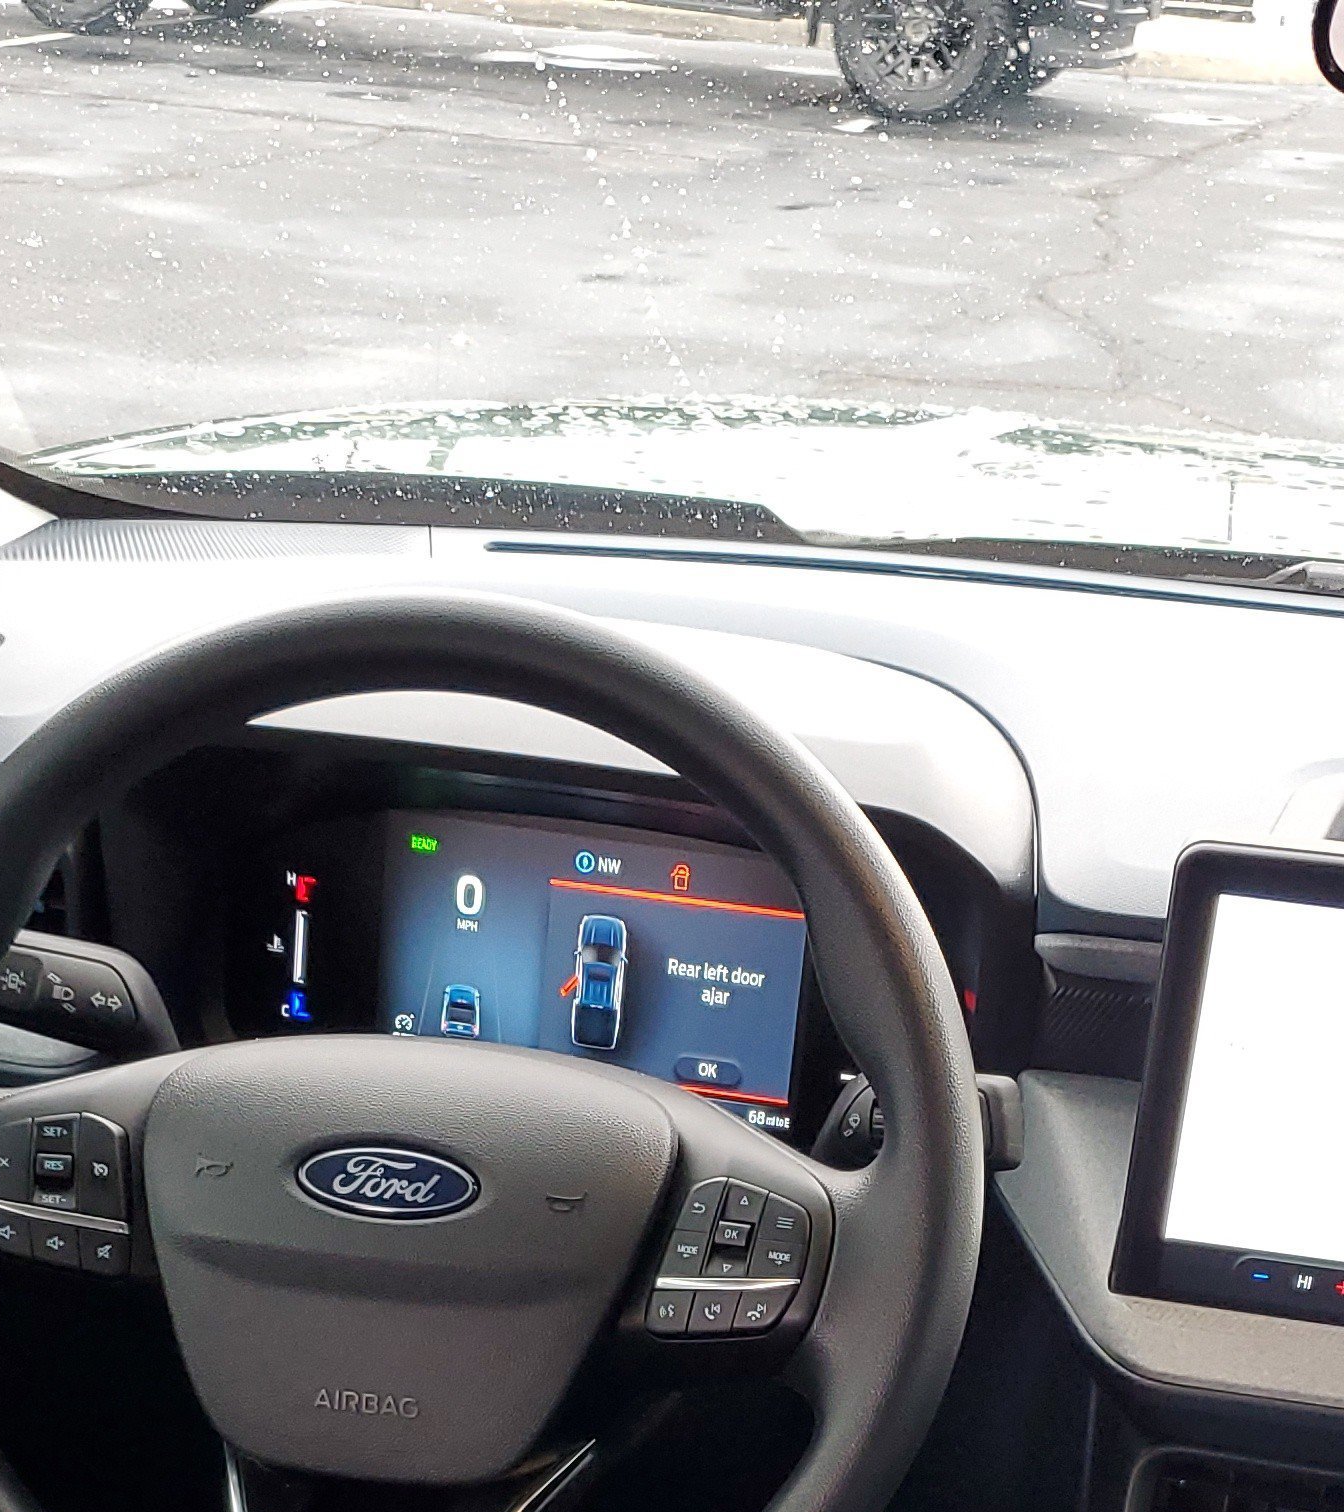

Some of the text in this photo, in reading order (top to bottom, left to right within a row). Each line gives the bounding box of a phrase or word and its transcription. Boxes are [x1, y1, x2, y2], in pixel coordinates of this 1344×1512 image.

[411, 834, 438, 852] READY
[597, 857, 622, 875] NW
[286, 870, 297, 886] H
[456, 874, 484, 916] 0
[457, 918, 479, 933] MPH
[667, 957, 766, 988] Rear left door
[701, 987, 731, 1006] ajar
[281, 1004, 290, 1018] C
[698, 1062, 718, 1079] OK
[748, 1110, 766, 1126] 68
[43, 1160, 64, 1171] RES
[332, 1155, 442, 1204] Ford
[724, 1228, 740, 1240] OK
[676, 1244, 699, 1256] MODE
[767, 1250, 792, 1263] MODE
[1296, 1274, 1313, 1291] HI
[314, 1388, 419, 1419] AIRBAG
